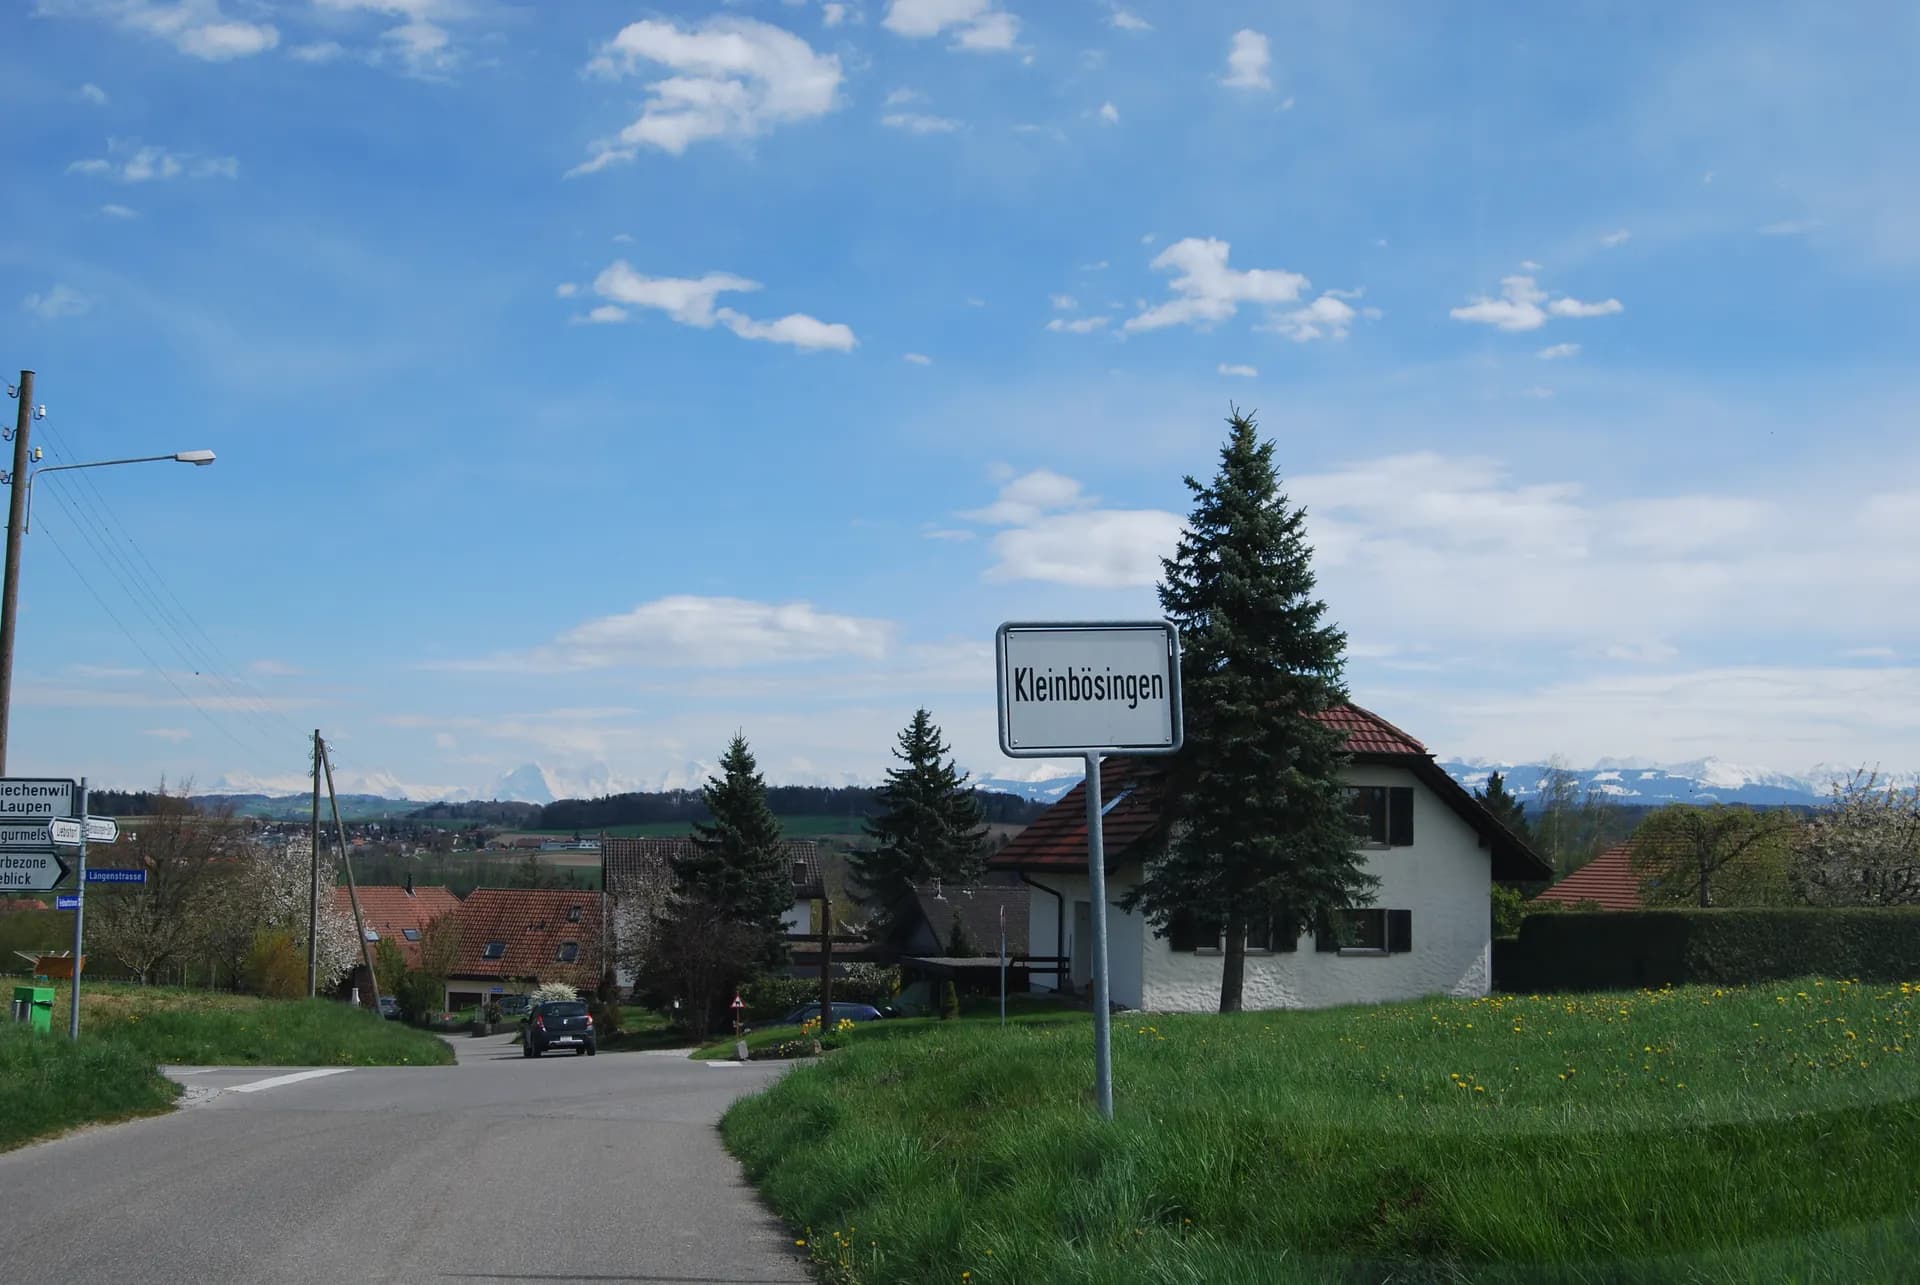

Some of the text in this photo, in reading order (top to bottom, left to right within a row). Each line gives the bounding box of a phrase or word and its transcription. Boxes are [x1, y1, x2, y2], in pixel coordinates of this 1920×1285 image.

[1014, 666, 1164, 710] Kleinbösingen
[0, 800, 52, 815] Laupen
[1, 829, 47, 843] gurmels
[89, 871, 142, 881] Längenstrasse
